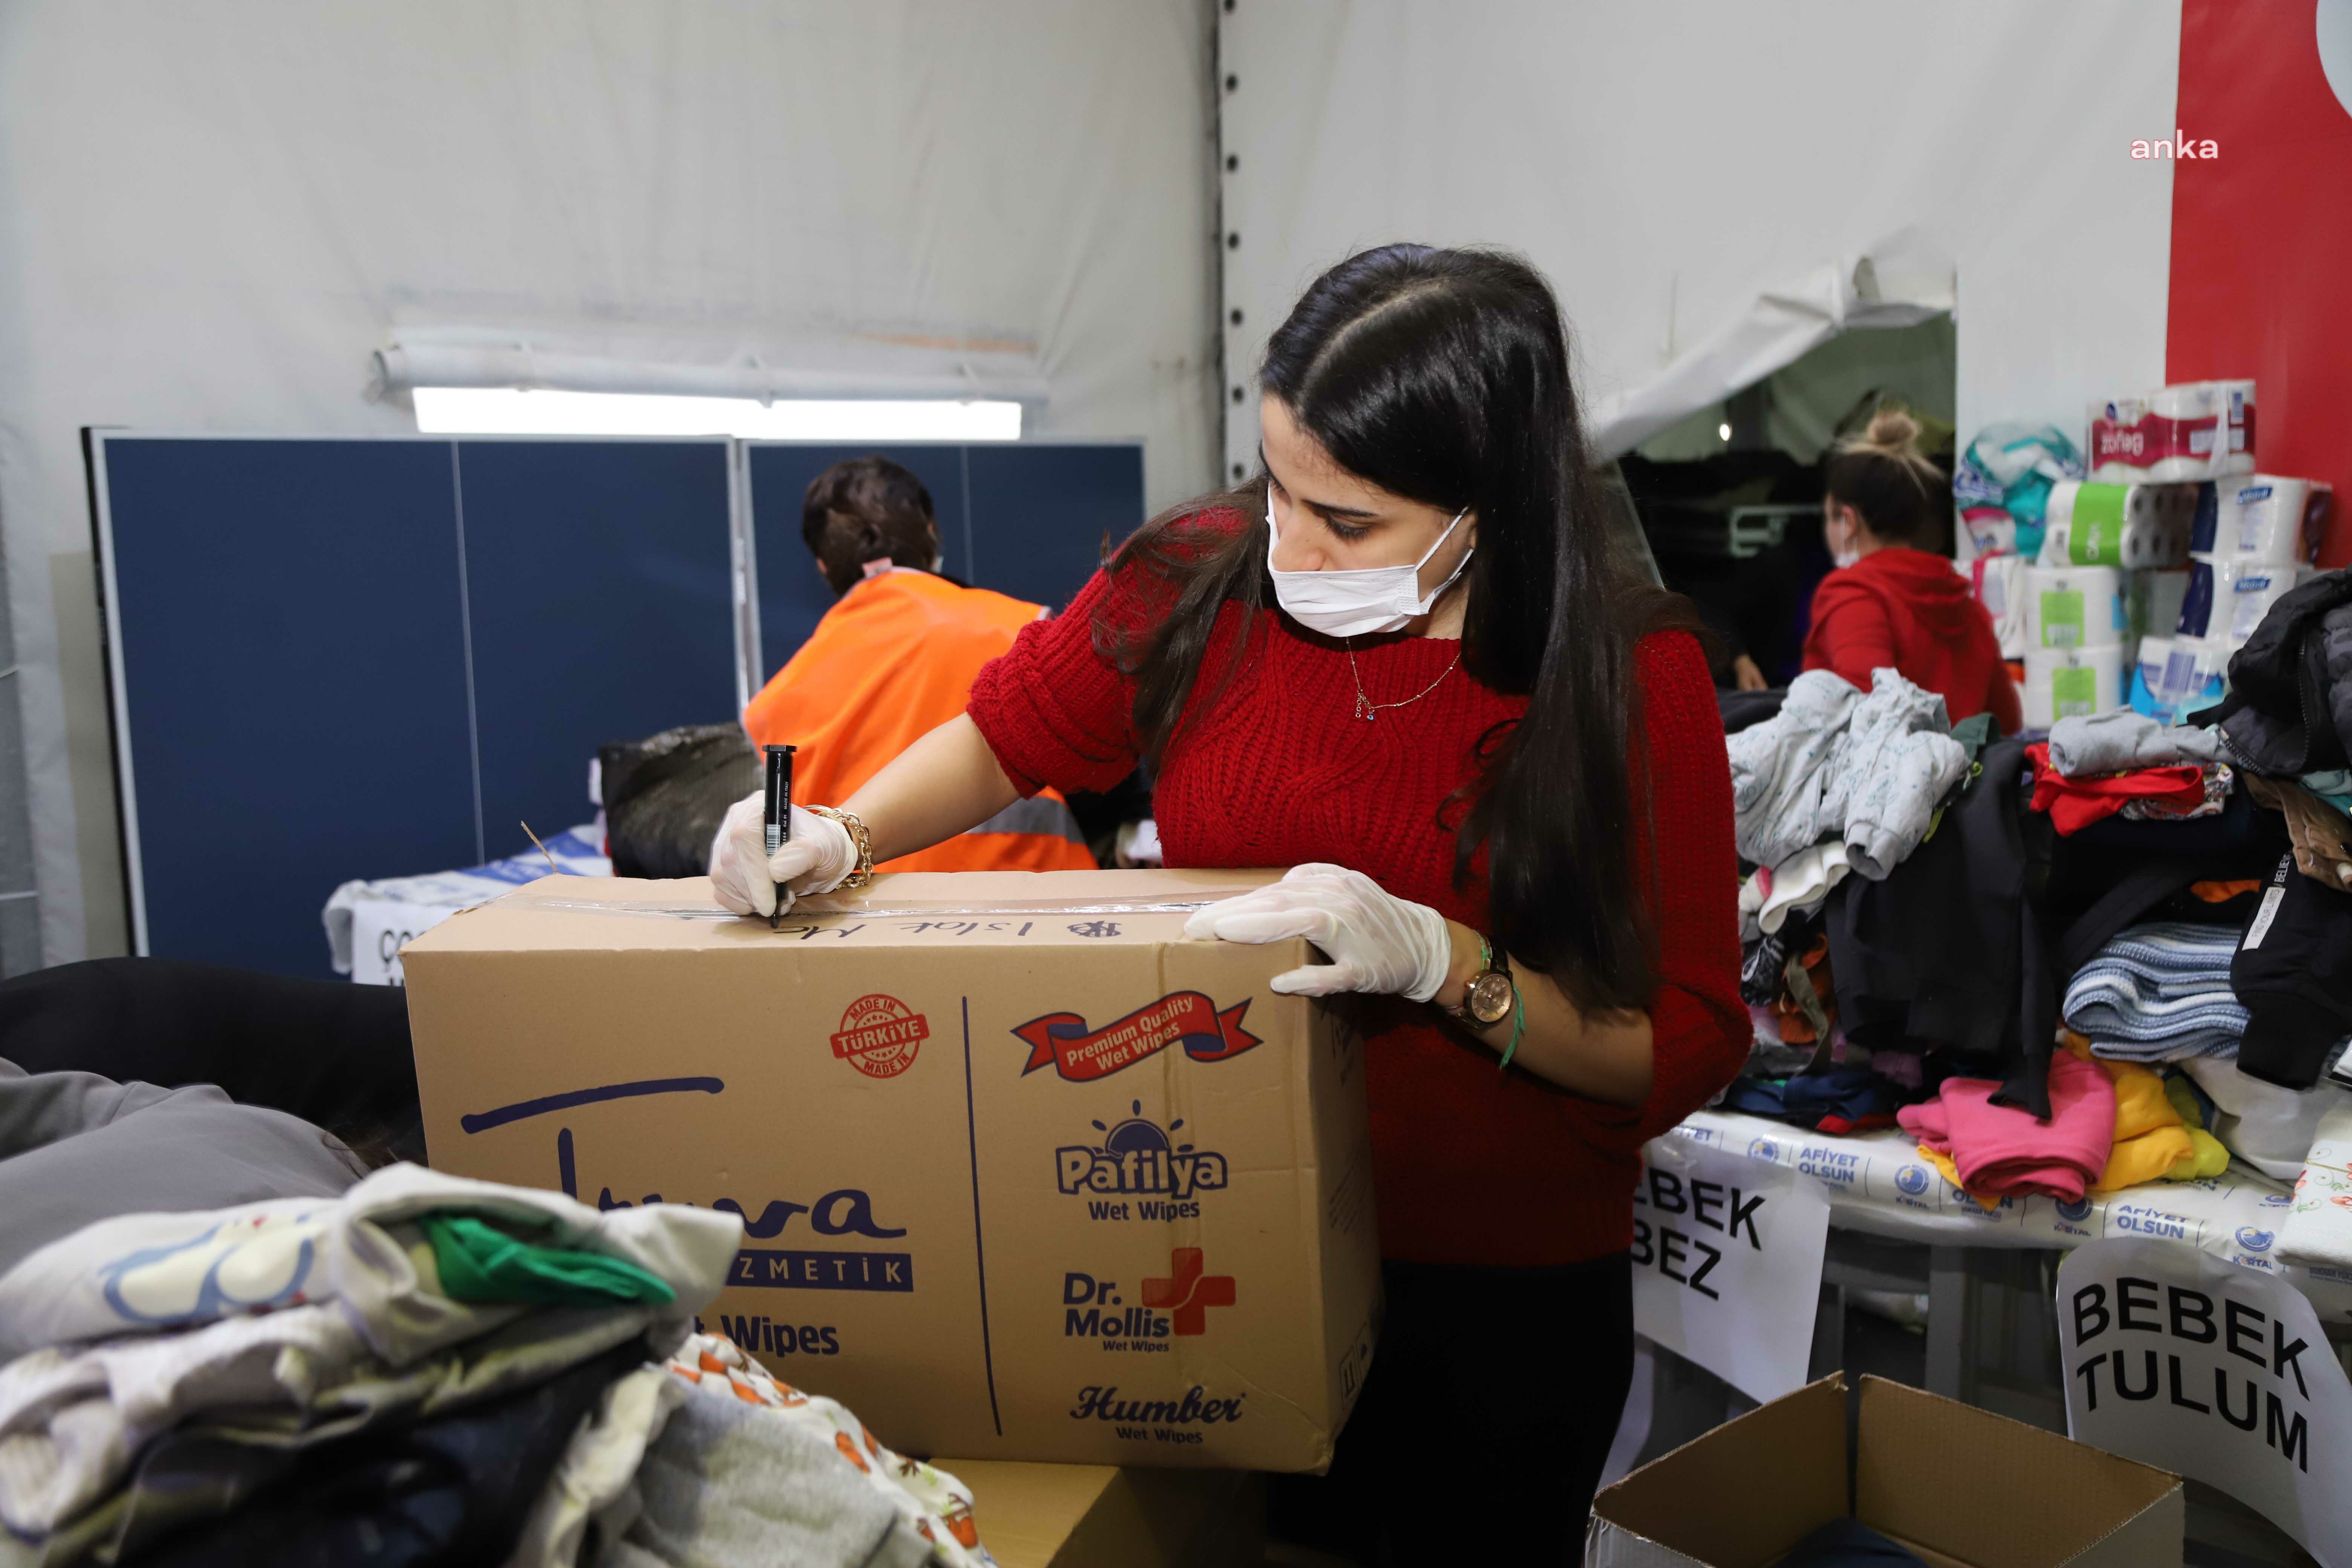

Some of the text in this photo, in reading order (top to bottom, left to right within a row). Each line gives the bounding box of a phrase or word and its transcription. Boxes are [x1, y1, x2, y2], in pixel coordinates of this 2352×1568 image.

[850, 999, 896, 1020] MADE IN
[1067, 997, 1193, 1066] Premium Quality
[1096, 1022, 1180, 1070] Wet Wipes
[864, 1053, 910, 1074] MADE IN
[1056, 1146, 1228, 1199] Pafilya
[1799, 1162, 1854, 1182] OLSUN
[1800, 1147, 1860, 1167] AFİYET
[1089, 1201, 1200, 1222] Wet Wipes
[1634, 1167, 1766, 1251] BEK
[2117, 1216, 2185, 1239] OLSUN
[740, 1257, 902, 1284] ZMETİK
[1631, 1218, 1721, 1301] BEZ
[1064, 1272, 1122, 1305] Dr.
[720, 1315, 839, 1358] Wipes
[1065, 1308, 1170, 1338] Mollis
[1103, 1340, 1170, 1353] Wet Wipes
[2073, 1277, 2310, 1402] BEBEK
[1070, 1385, 1243, 1424] Humber
[2076, 1350, 2307, 1474] TULUM
[1116, 1426, 1203, 1444] Wet Wipes
